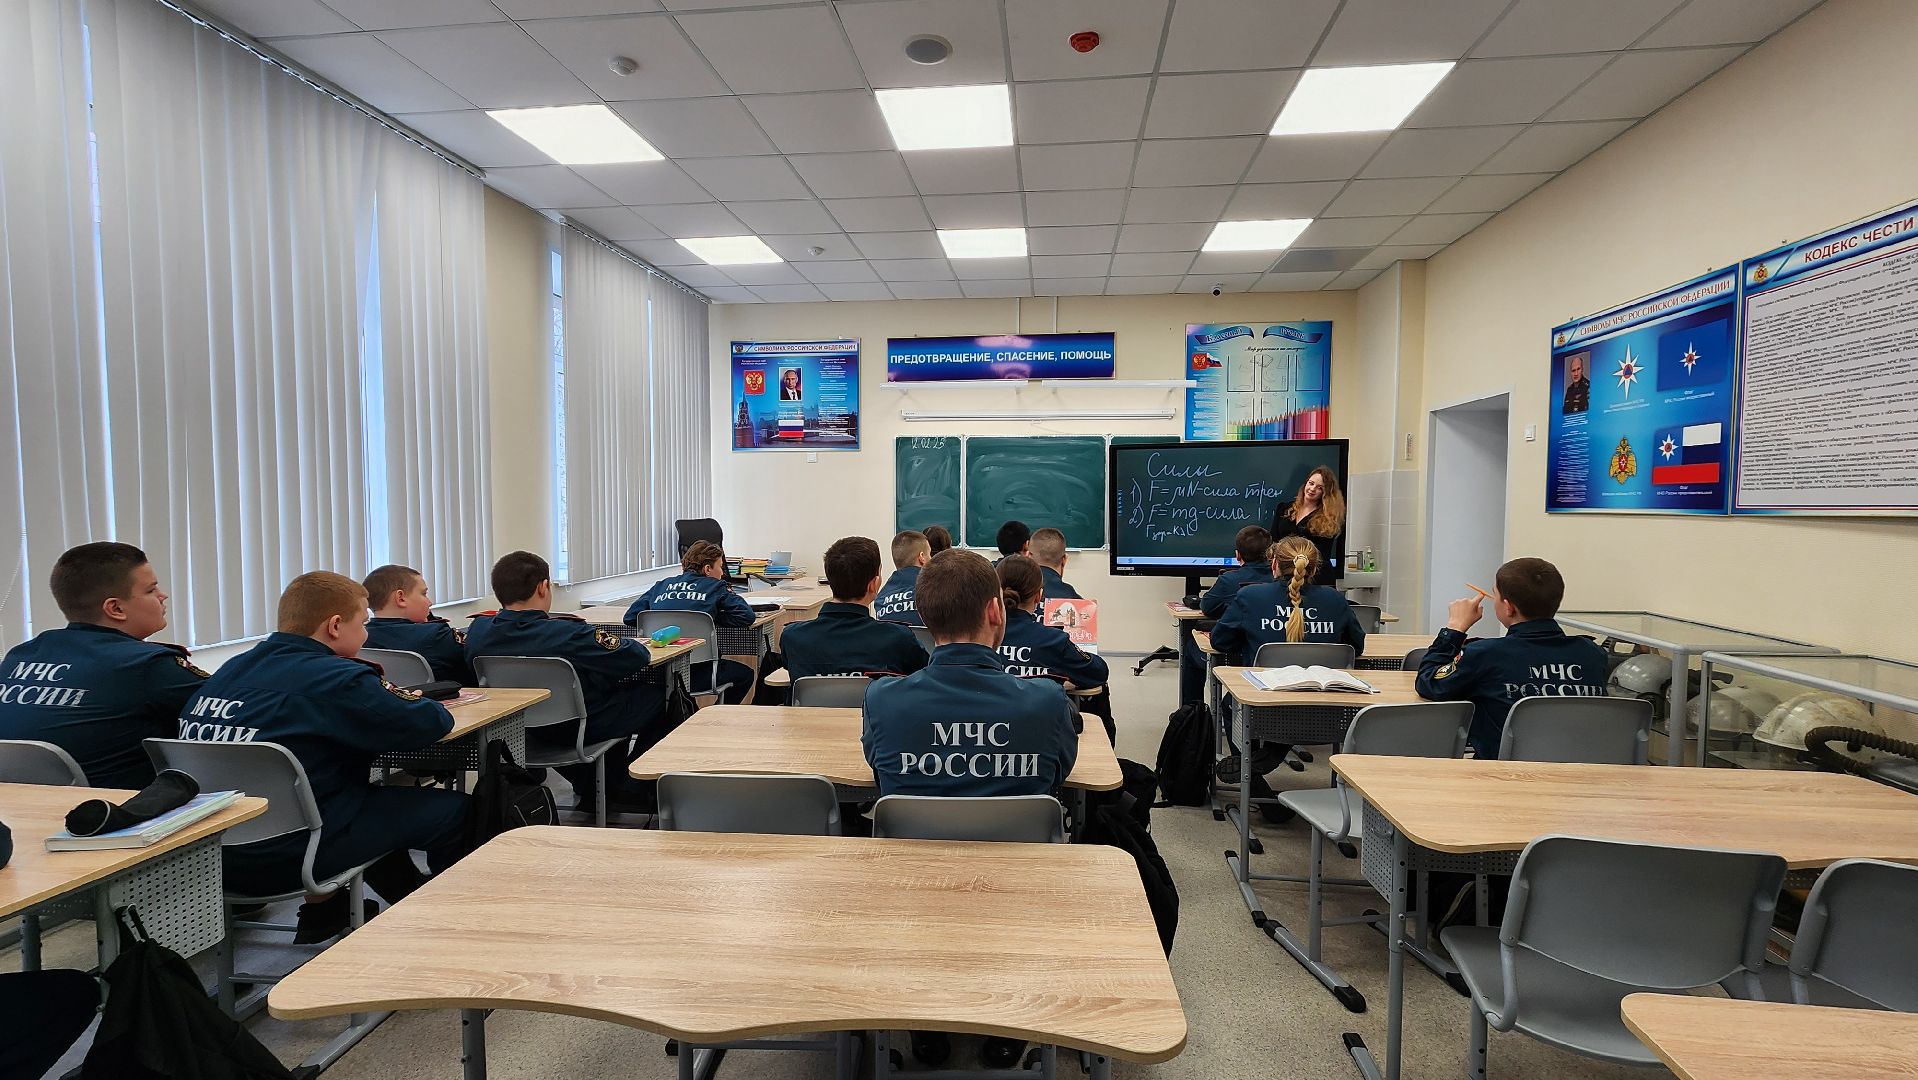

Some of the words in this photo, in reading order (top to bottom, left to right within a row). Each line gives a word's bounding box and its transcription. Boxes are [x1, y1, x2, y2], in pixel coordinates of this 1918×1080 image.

[1804, 236, 1858, 263] КОДЕКС
[1863, 216, 1915, 243] ЧЕСТИ
[1628, 296, 1679, 321] РОССИЙСКОЙ
[1680, 279, 1731, 304] ФЕДЕРАЦИИ
[890, 352, 994, 364] ПРЕДОТВРАЩЕНИЕ,
[996, 351, 1058, 362] СПАСЕНИЕ,
[1061, 350, 1111, 361] ПОМОЩЬ
[1147, 452, 1222, 478] Силы
[666, 581, 697, 591] МЧС
[654, 591, 707, 603] РОССИИ
[883, 590, 912, 605] МЧС
[995, 645, 1031, 662] ЧС
[8, 661, 72, 682] МЧС
[1528, 663, 1583, 681] МЧС
[190, 695, 244, 719] МЧС
[931, 722, 1010, 747] МЧС
[899, 752, 1040, 778] РОССИИ
